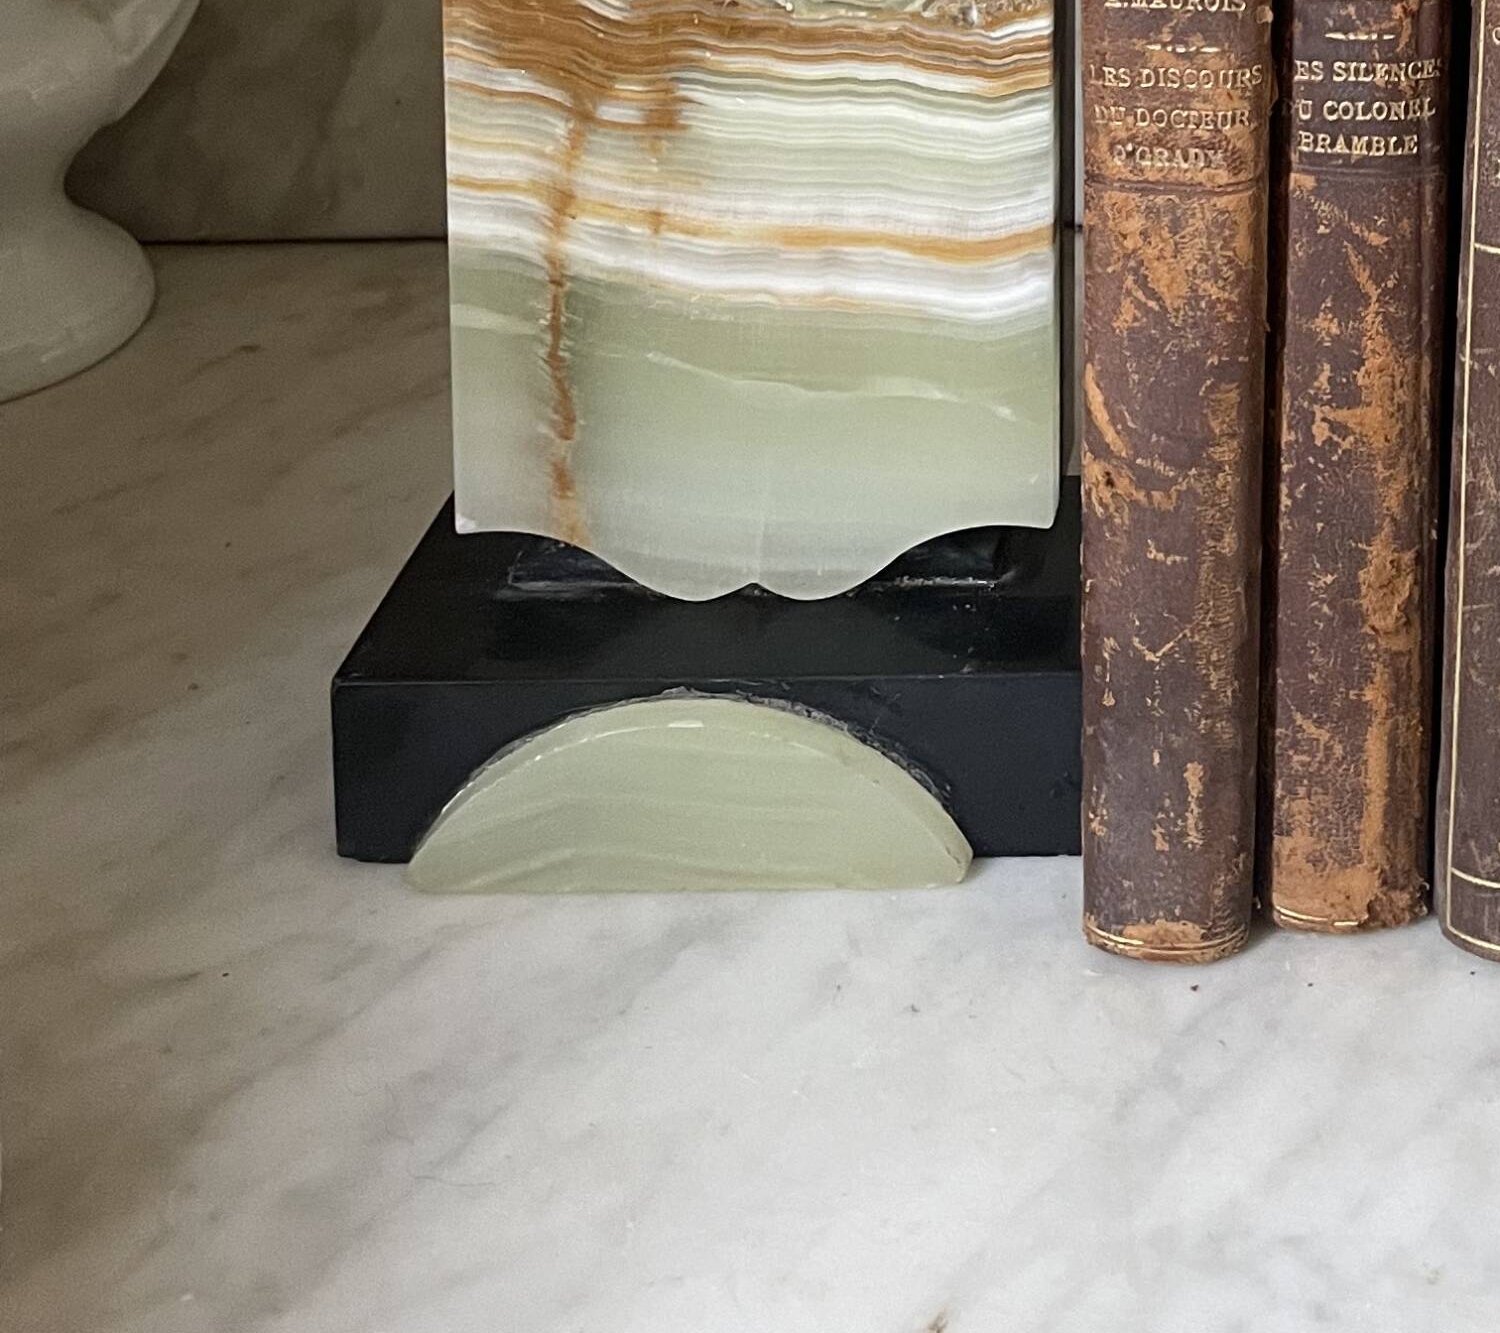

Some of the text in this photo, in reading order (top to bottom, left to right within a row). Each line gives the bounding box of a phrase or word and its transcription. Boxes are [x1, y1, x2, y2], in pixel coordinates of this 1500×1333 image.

[1139, 64, 1263, 89] DISCOURS
[1294, 59, 1324, 82] ES
[1136, 108, 1252, 130] DOCTEUR
[1293, 97, 1436, 122] U COLONEL
[1298, 130, 1419, 157] BRAMBLE
